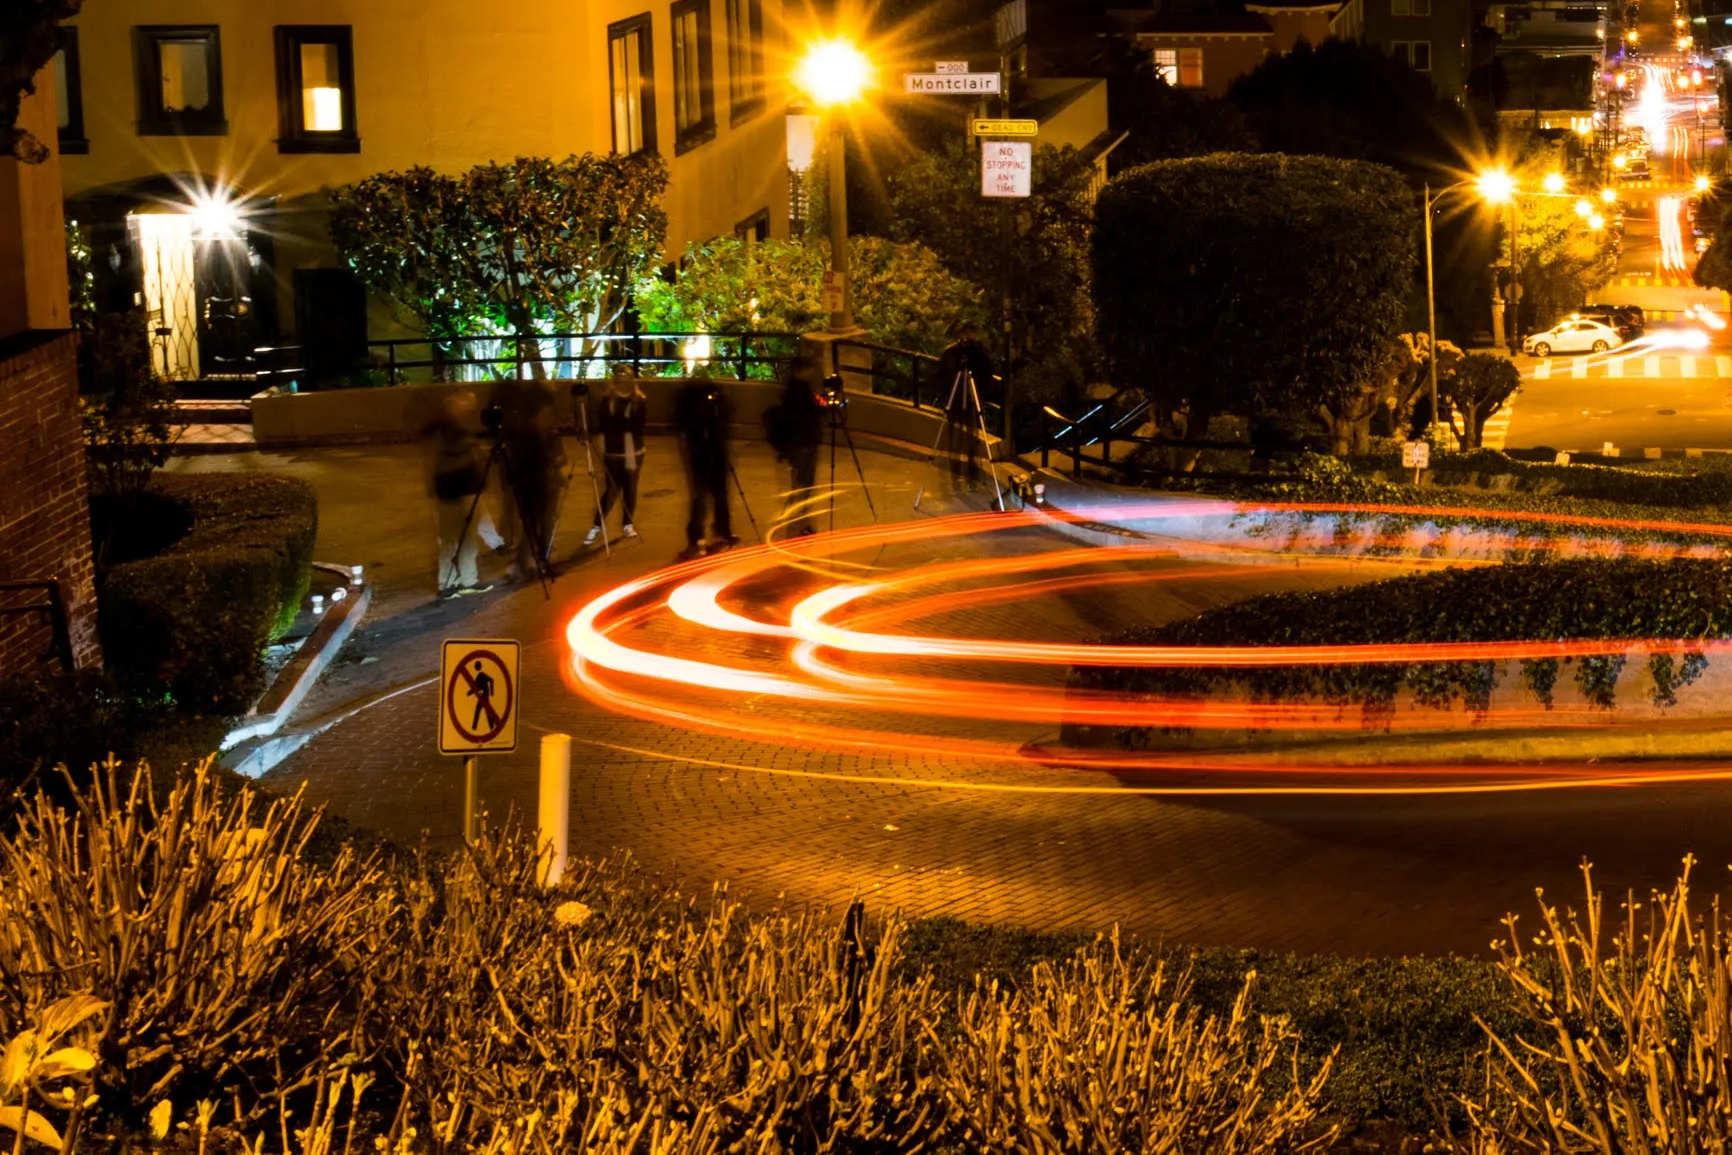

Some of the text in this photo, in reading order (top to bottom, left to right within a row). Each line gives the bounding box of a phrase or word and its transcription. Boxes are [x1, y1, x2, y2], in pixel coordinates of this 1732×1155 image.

[912, 78, 992, 90] Montclair
[992, 124, 1033, 132] DEAD END
[999, 147, 1014, 156] NO
[986, 160, 1026, 170] STOPPING
[996, 174, 1015, 182] ANY
[996, 185, 1016, 193] TIME
